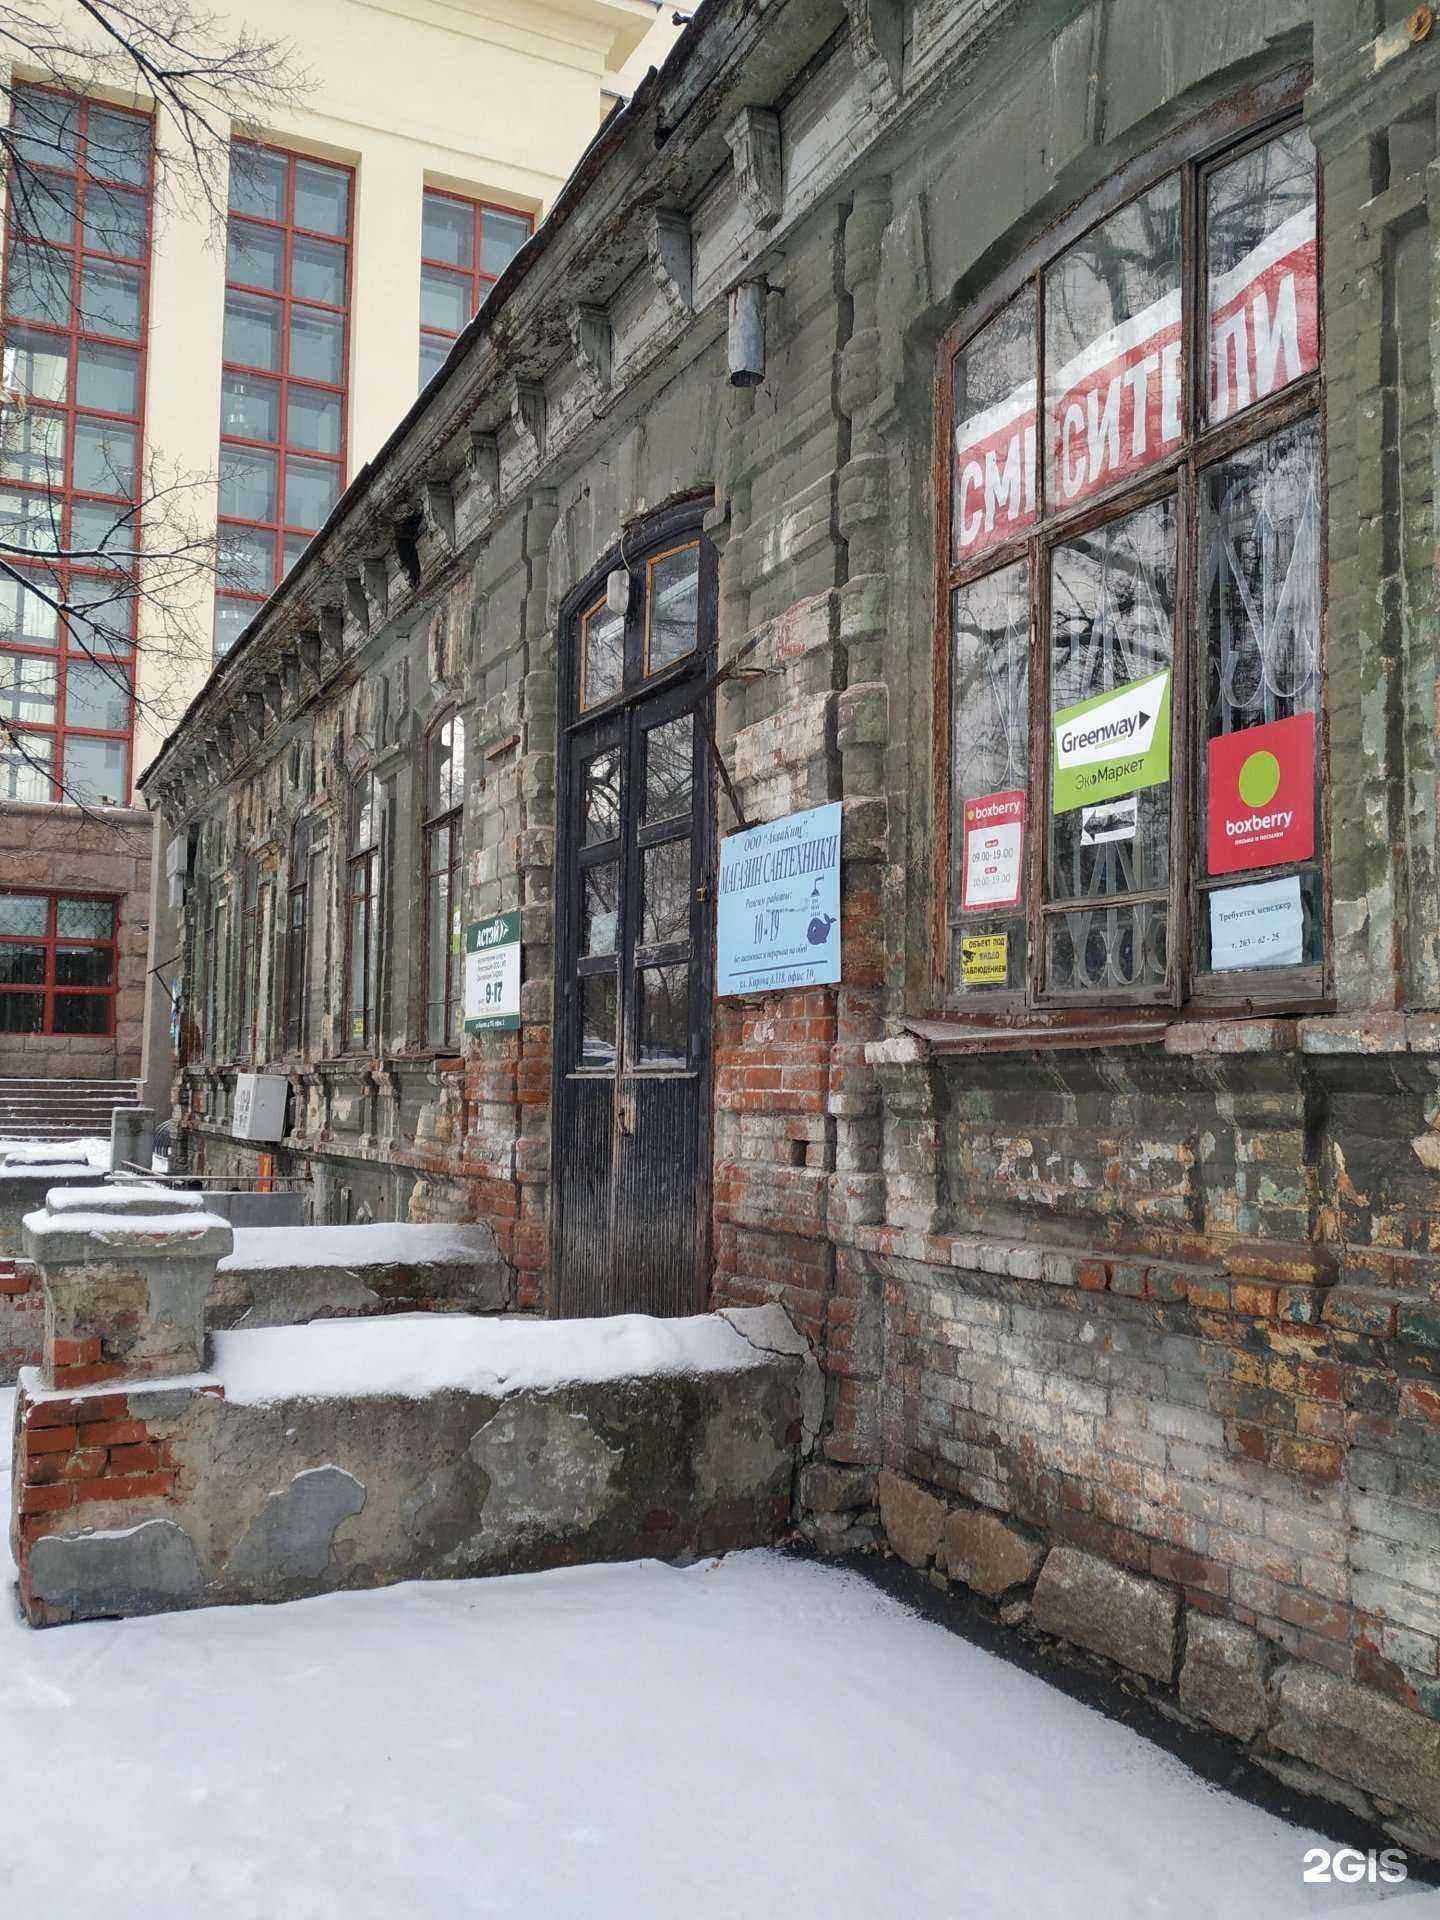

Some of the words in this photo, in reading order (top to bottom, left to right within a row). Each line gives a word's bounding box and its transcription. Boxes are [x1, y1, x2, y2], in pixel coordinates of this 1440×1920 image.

[1061, 714, 1138, 753] Greenway
[1075, 758, 1145, 790] ЭкоМаркет
[975, 800, 1021, 820] boxberry
[1225, 810, 1294, 836] boxberry
[744, 835, 762, 852] ООО
[719, 855, 763, 895] МАГАЗИН
[763, 835, 838, 884] САНТЕХНИКИ
[1219, 908, 1255, 923] Требуется
[1257, 901, 1292, 915] менеджер
